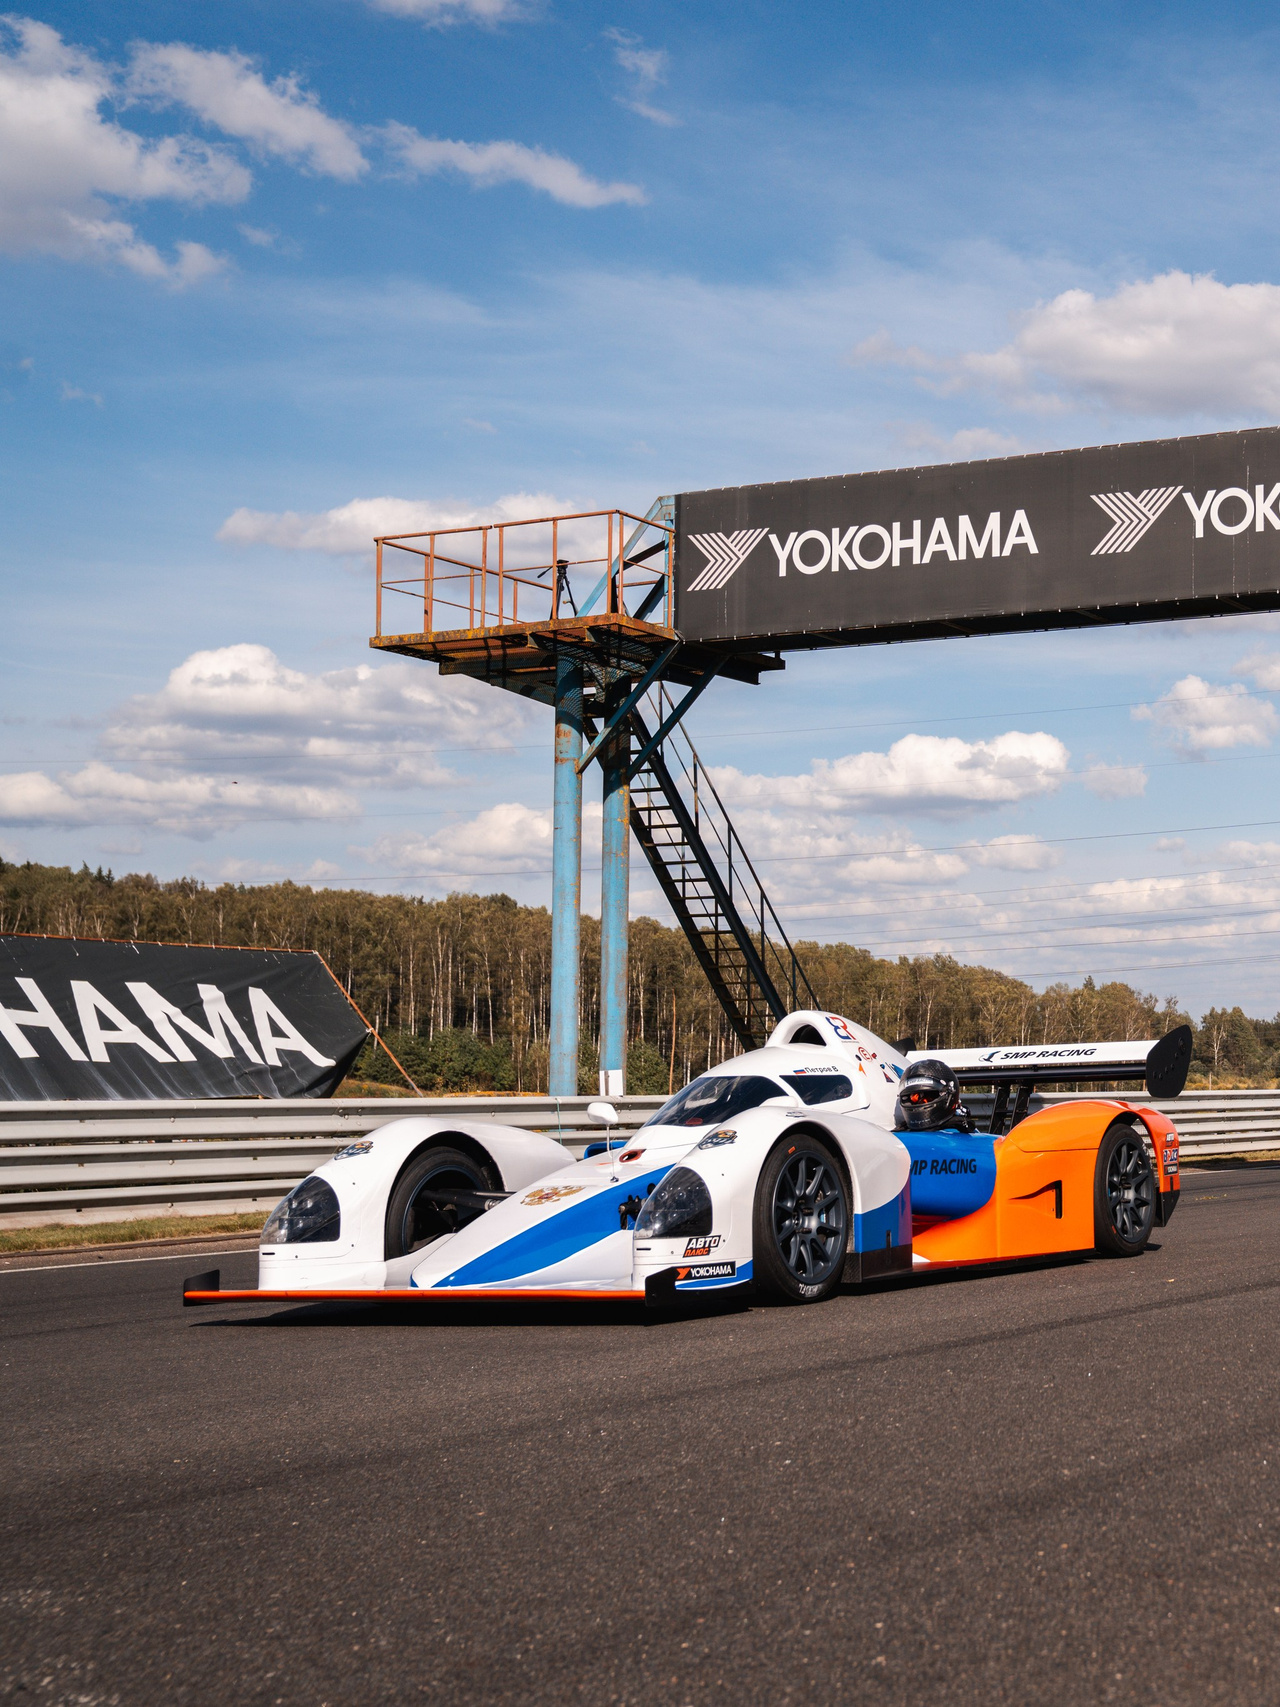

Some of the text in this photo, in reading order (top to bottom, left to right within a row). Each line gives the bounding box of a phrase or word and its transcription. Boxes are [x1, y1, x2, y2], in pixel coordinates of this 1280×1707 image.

[768, 510, 1038, 576] YOKOHAMA
[0, 976, 336, 1067] HAMA
[1000, 1048, 1097, 1060] SMP RACING
[929, 1158, 977, 1175] RACING
[688, 1237, 719, 1248] АВТО
[691, 1265, 732, 1277] YOKOHAMA
